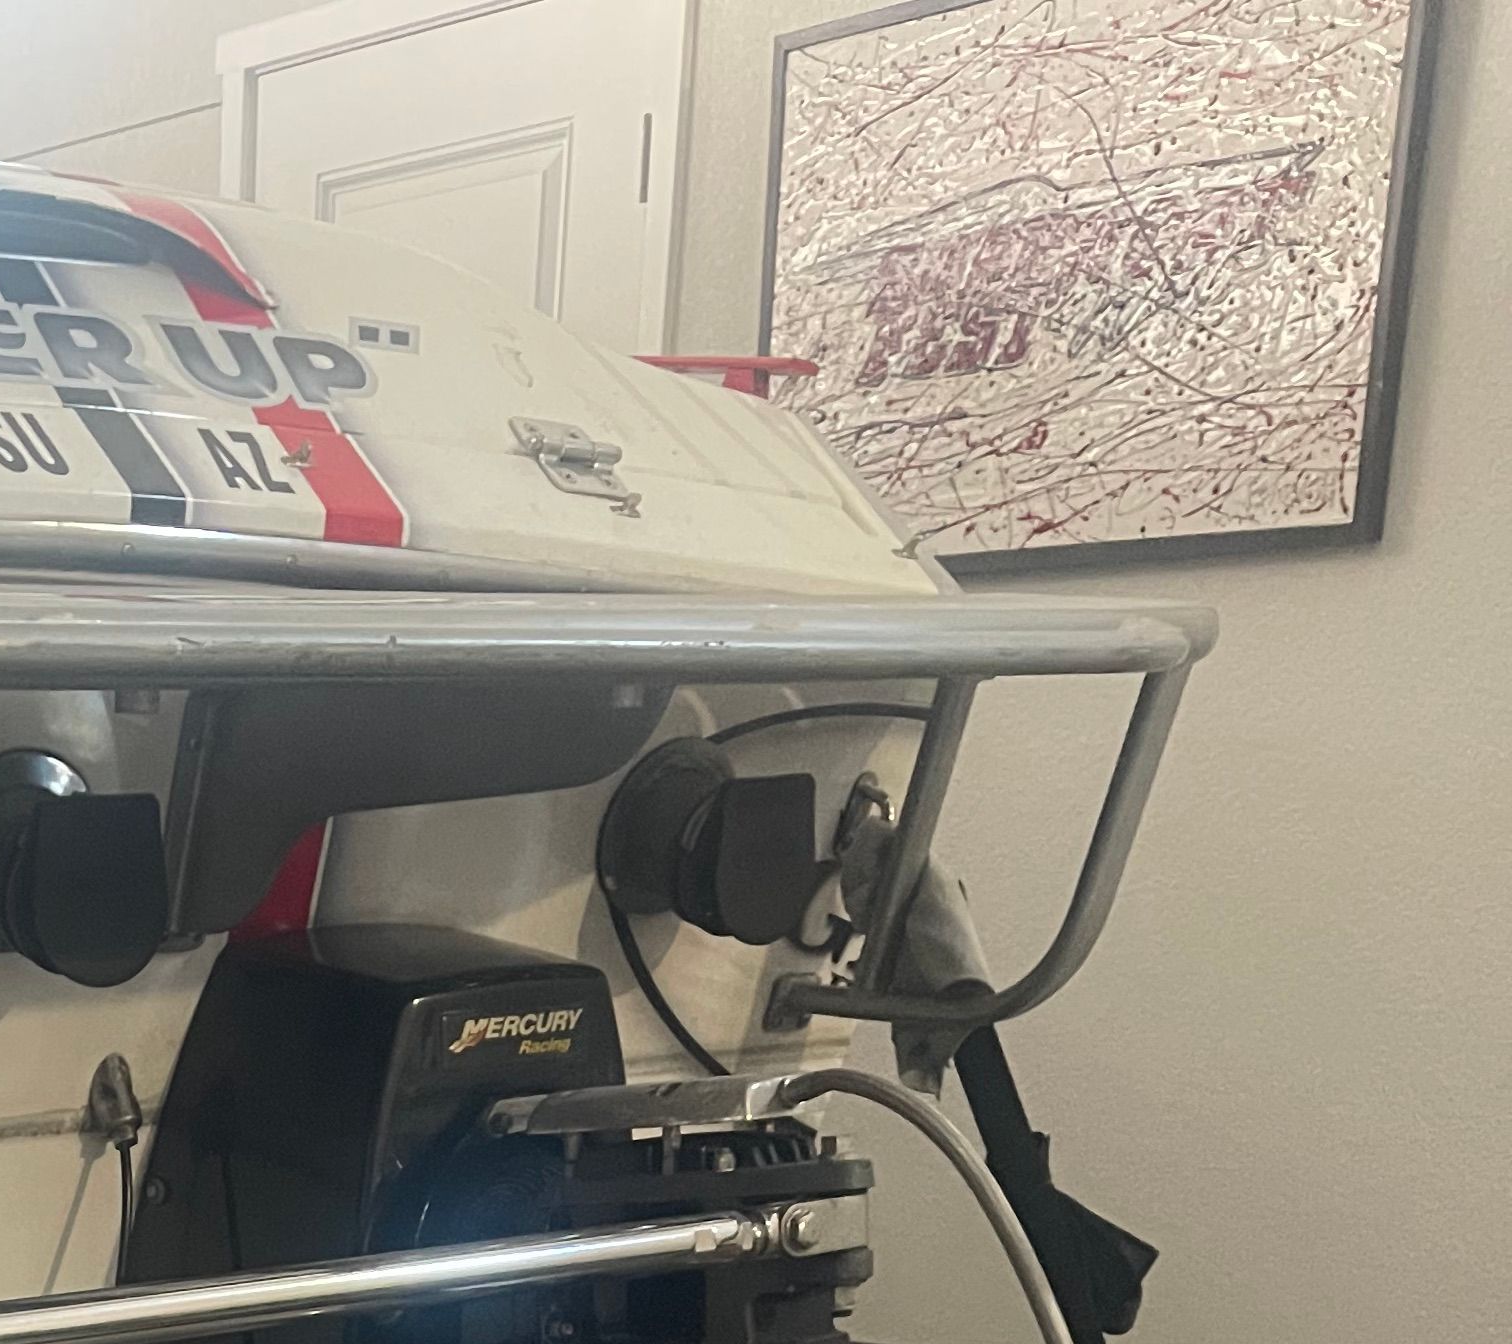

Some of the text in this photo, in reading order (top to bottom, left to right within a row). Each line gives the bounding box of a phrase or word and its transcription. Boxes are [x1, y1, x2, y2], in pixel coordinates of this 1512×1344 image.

[196, 428, 297, 494] AZ
[449, 1008, 584, 1052] MERCURY
[519, 1038, 571, 1054] Racing
